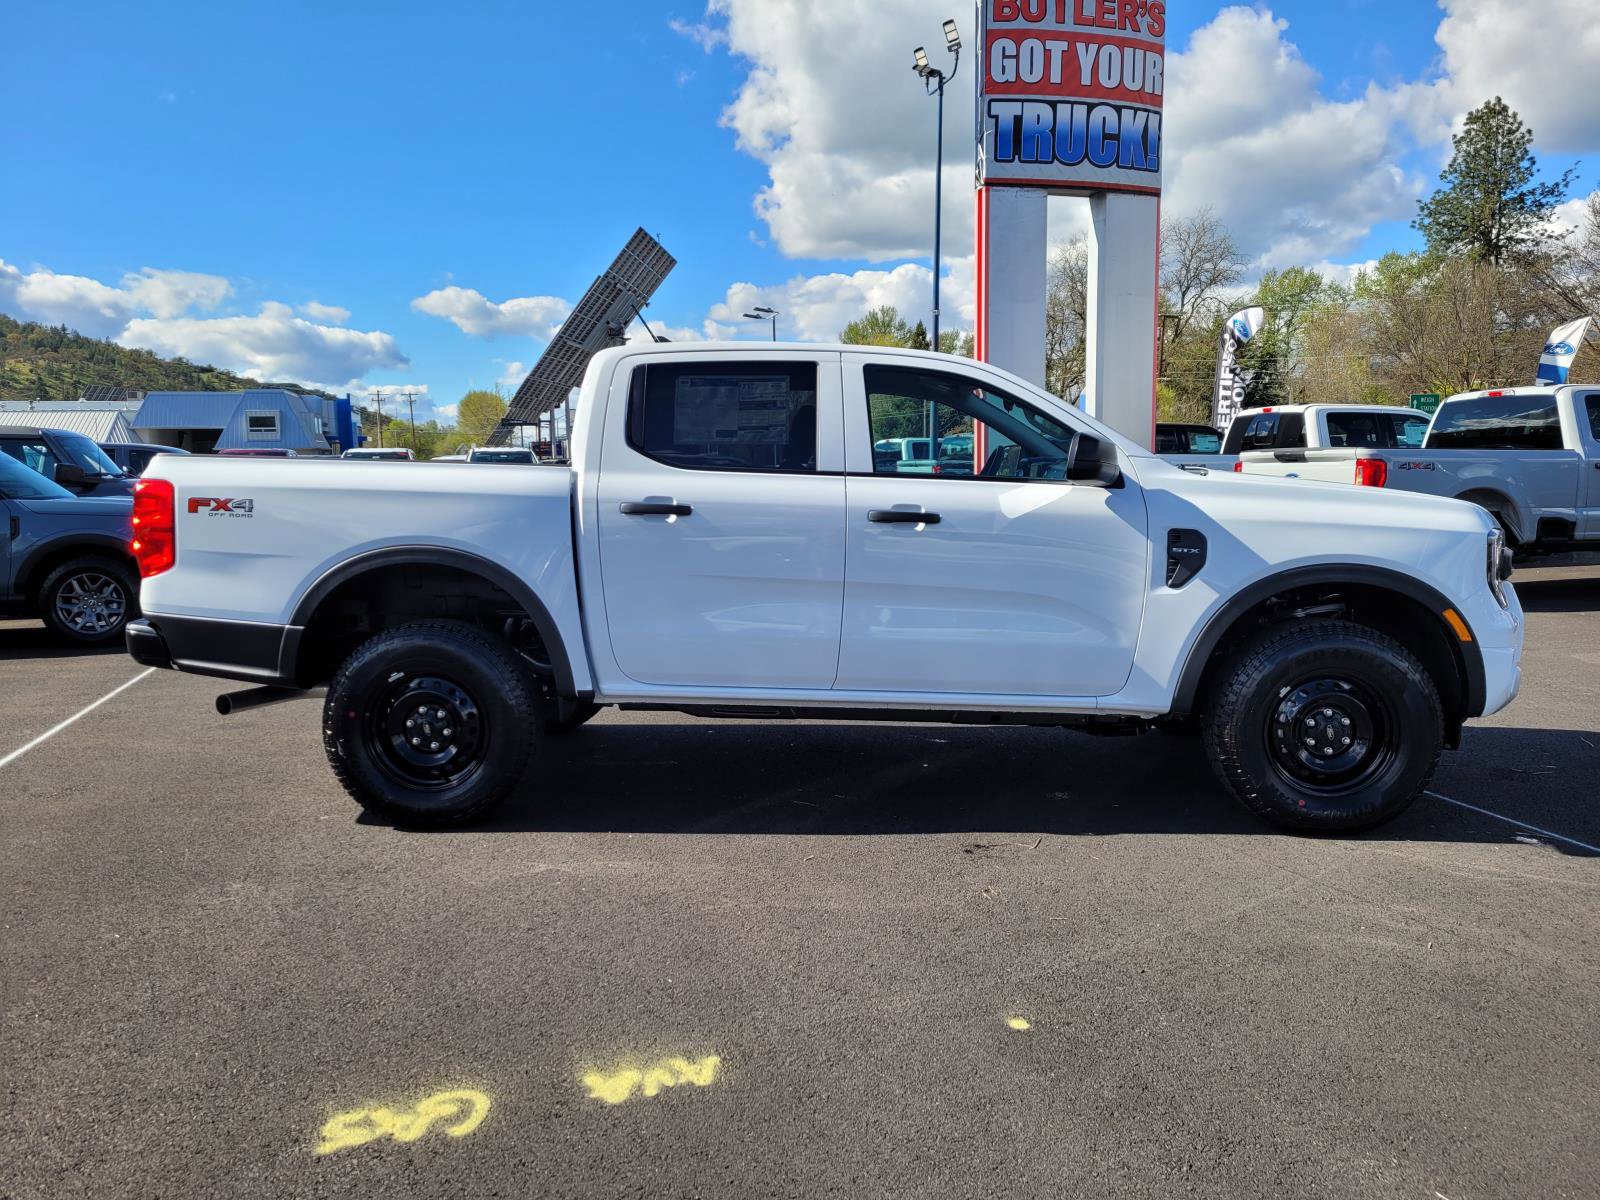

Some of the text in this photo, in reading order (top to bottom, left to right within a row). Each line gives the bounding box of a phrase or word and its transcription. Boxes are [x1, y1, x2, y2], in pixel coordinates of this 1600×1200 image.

[990, 37, 1164, 96] GOT YOUR
[988, 100, 1162, 173] TRUCK!
[187, 497, 254, 513] FX4
